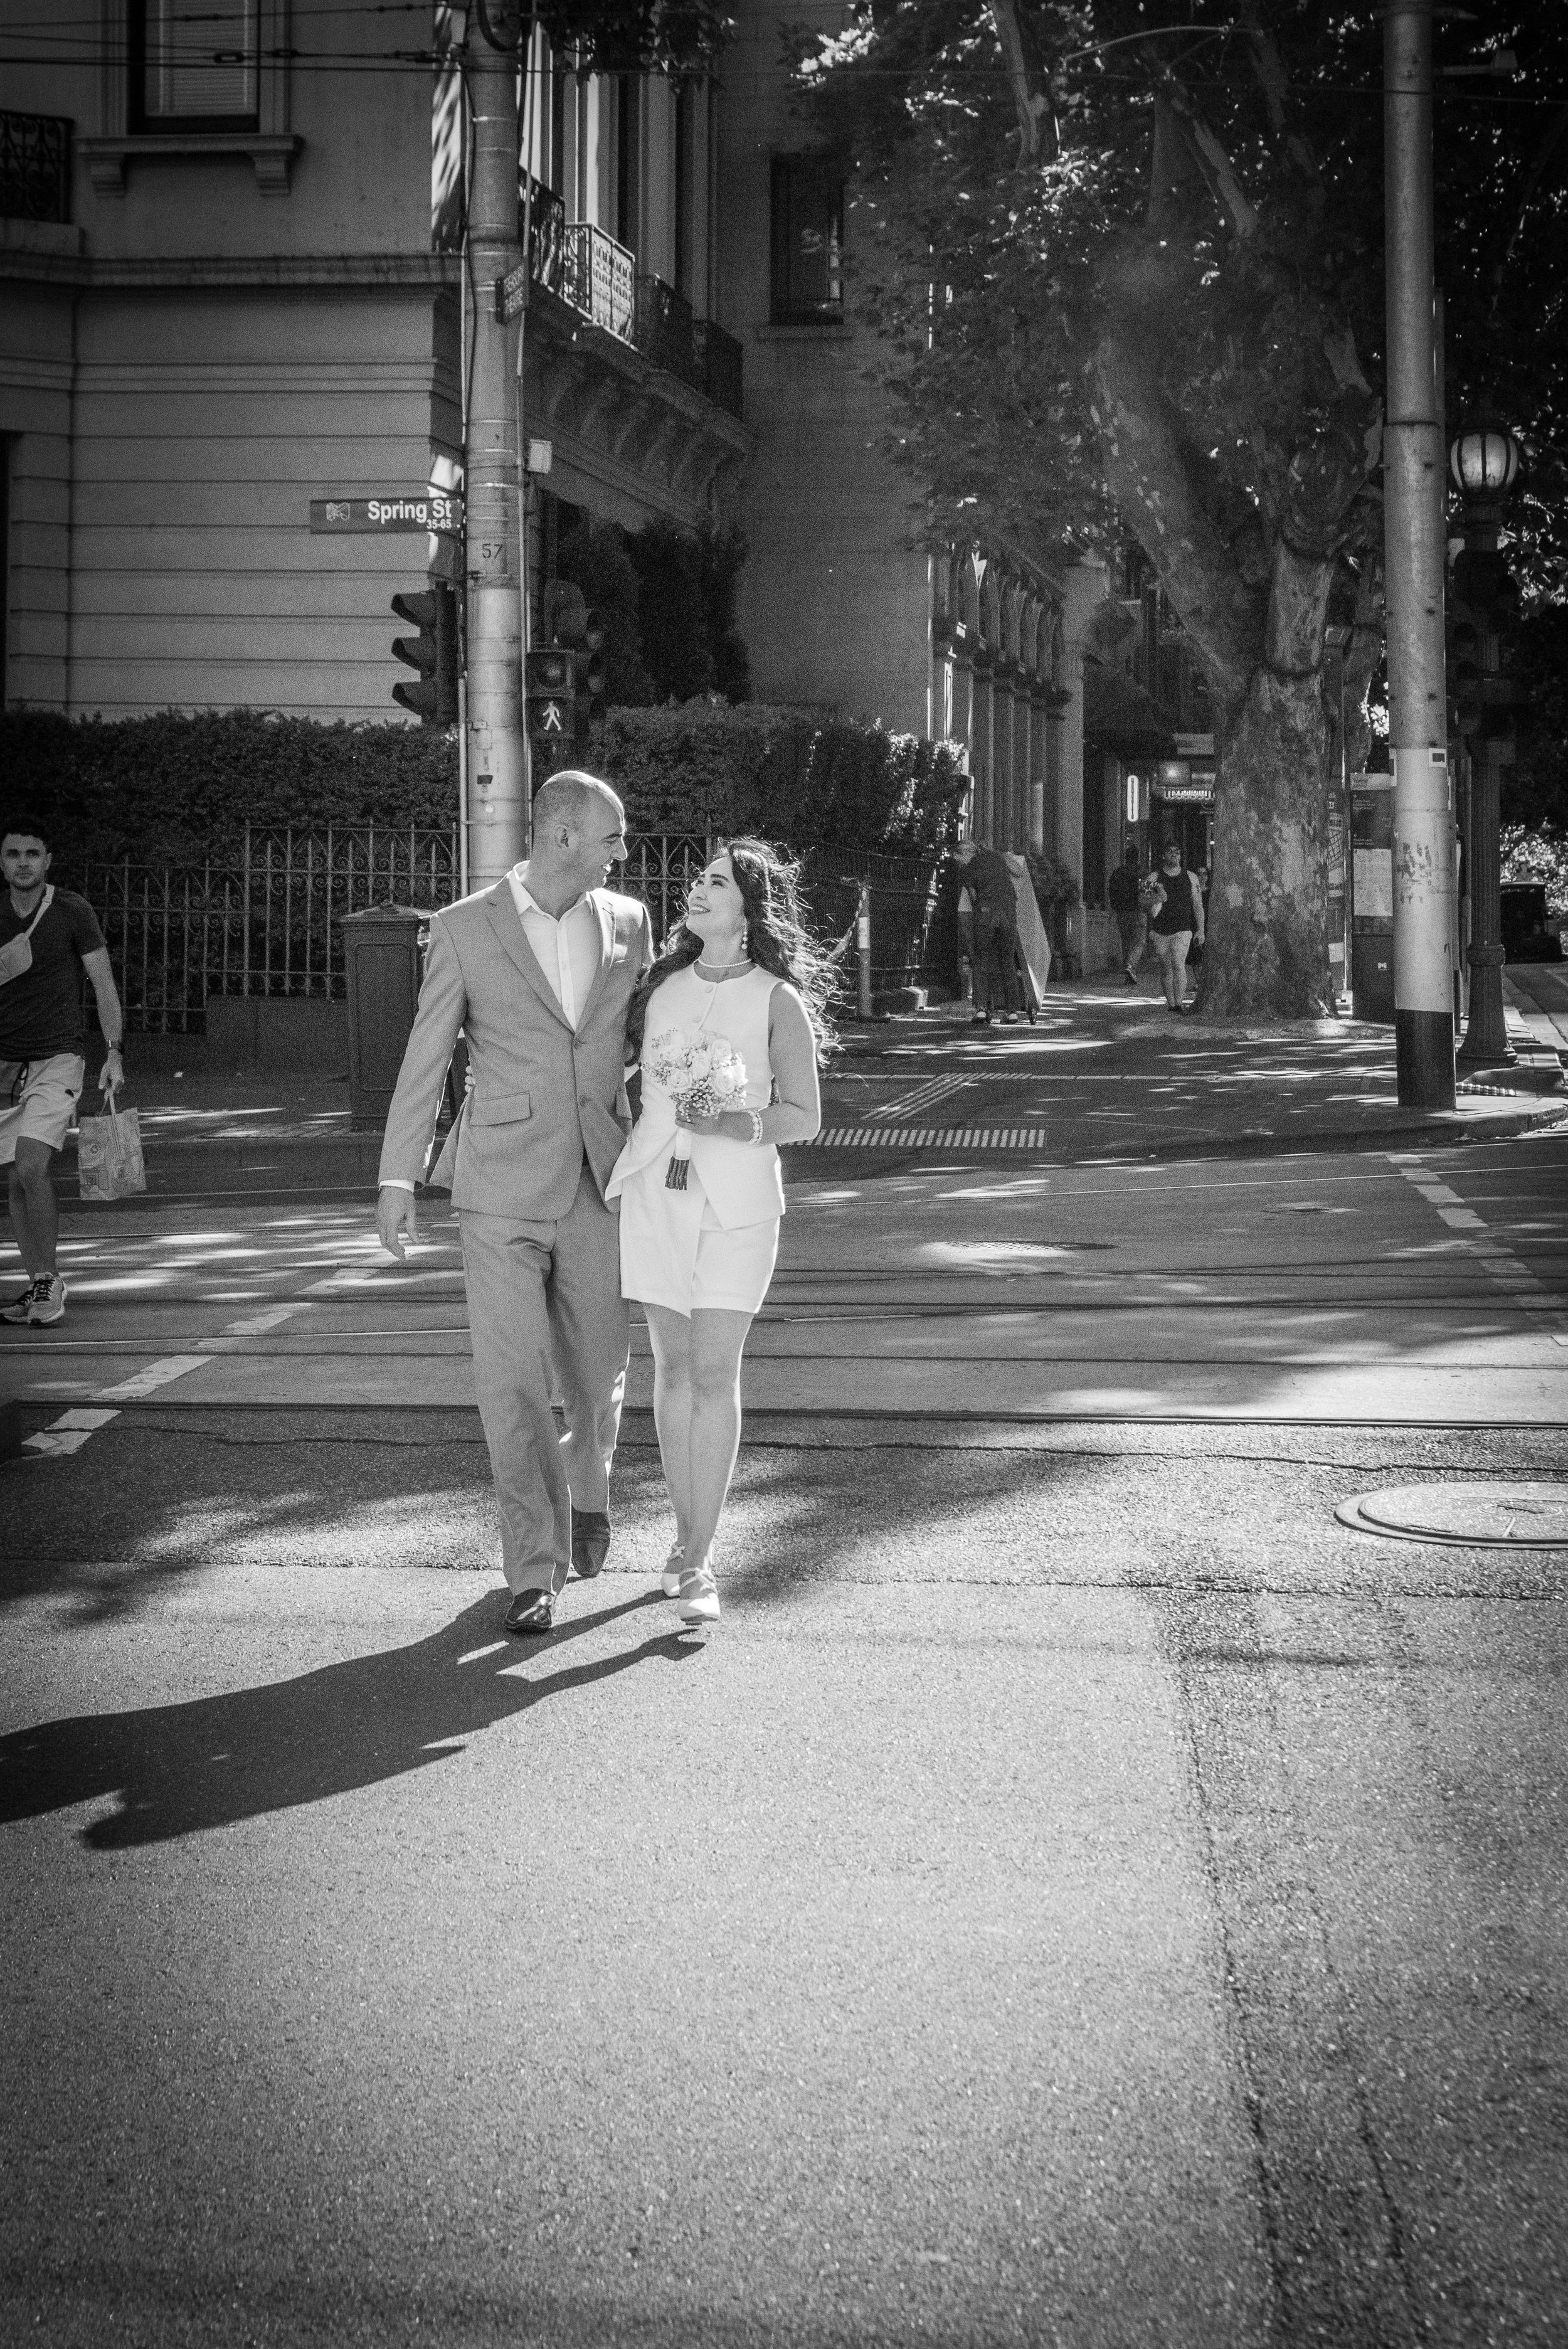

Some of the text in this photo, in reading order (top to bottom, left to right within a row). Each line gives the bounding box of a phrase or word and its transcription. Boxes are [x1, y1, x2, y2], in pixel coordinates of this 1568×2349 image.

[368, 499, 452, 524] Spring St
[426, 519, 452, 530] 35-65
[482, 543, 504, 559] 57
